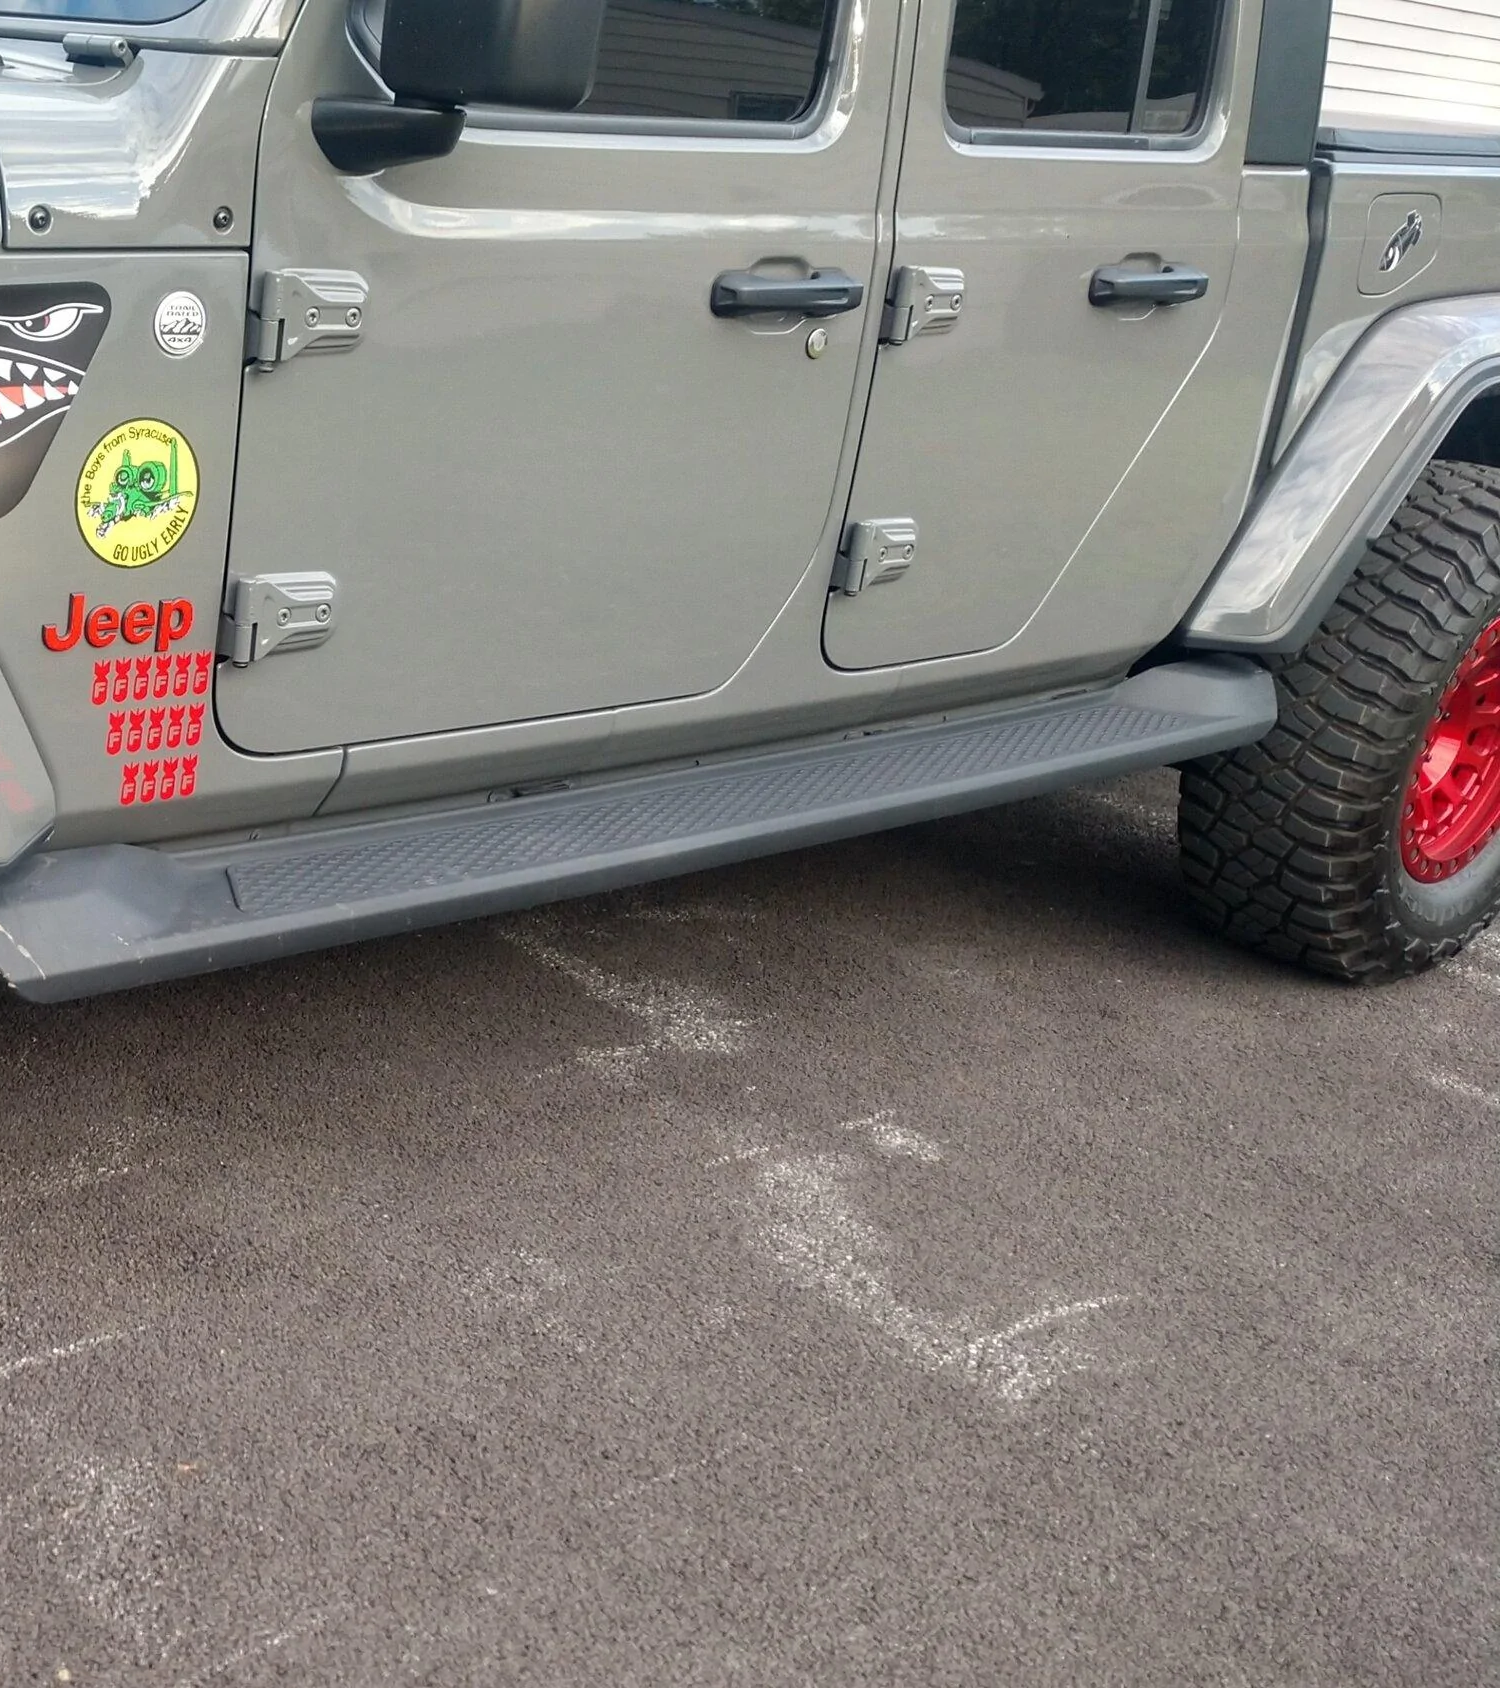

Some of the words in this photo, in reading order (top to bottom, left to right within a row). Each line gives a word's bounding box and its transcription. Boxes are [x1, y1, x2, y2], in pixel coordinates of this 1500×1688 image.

[103, 432, 127, 454] from
[128, 426, 172, 446] Syracuse
[85, 451, 106, 481] Boys
[80, 483, 93, 507] the
[113, 543, 129, 561] GO
[131, 537, 160, 562] UGLY
[160, 504, 189, 546] EARLY
[41, 592, 194, 652] Jeep
[94, 682, 106, 698] F
[114, 679, 127, 695] F
[135, 677, 148, 693] F
[154, 675, 167, 692] F
[174, 673, 188, 690] F
[194, 671, 207, 688] F
[108, 732, 121, 748] F
[128, 729, 141, 746] F
[148, 727, 161, 744] F
[168, 725, 181, 741] F
[188, 723, 201, 739] F
[123, 783, 135, 799] F
[142, 780, 155, 797] F
[162, 778, 175, 794] F
[182, 775, 194, 791] F
